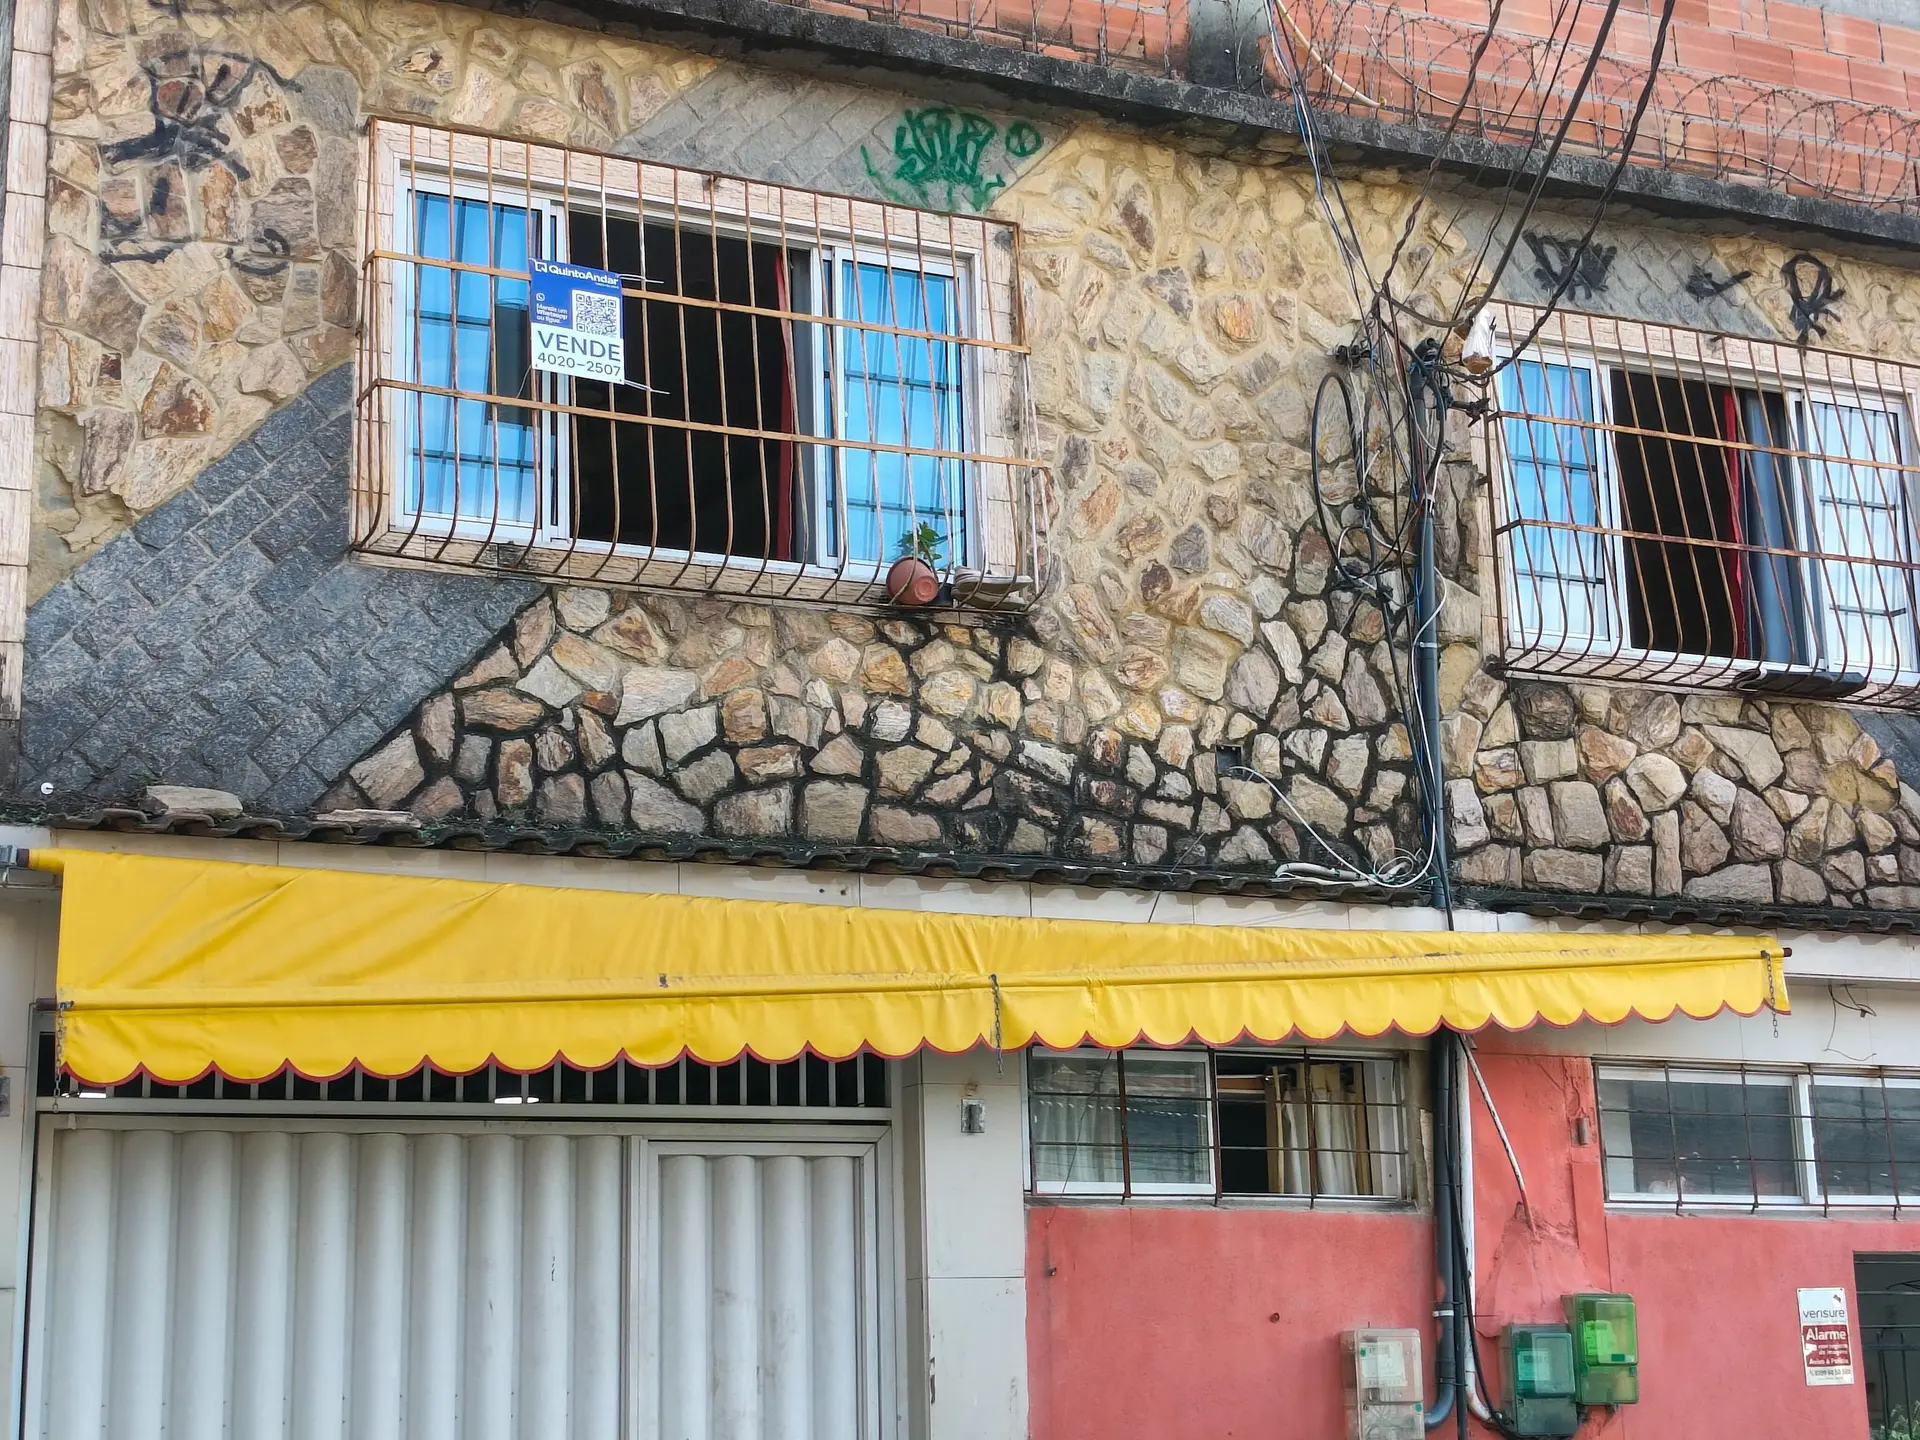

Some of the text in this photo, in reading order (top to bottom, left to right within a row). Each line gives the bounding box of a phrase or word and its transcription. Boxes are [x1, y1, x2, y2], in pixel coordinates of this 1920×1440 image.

[548, 264, 619, 286] QuintoAndar
[537, 330, 621, 362] VENDE
[537, 352, 621, 377] 4020-2507
[1802, 1309, 1845, 1319] verisure
[1805, 1327, 1847, 1341] Alarme
